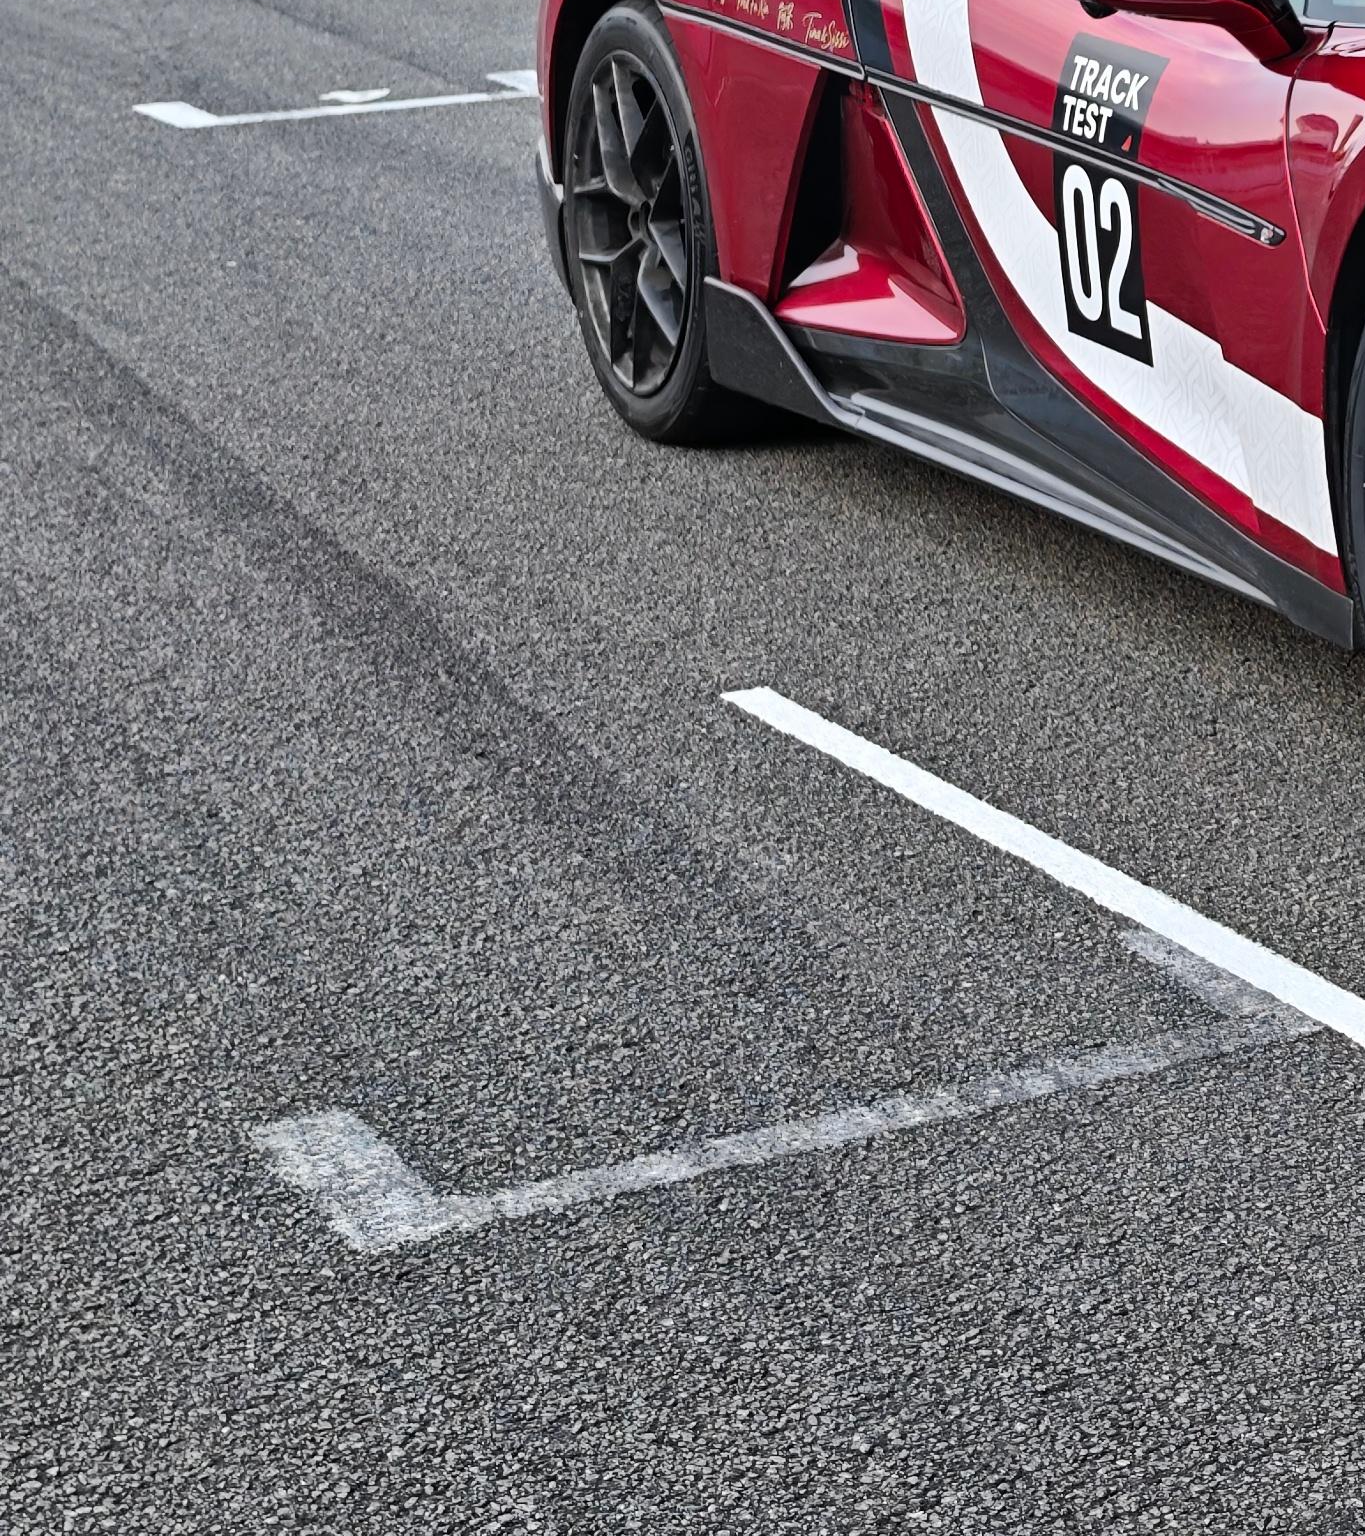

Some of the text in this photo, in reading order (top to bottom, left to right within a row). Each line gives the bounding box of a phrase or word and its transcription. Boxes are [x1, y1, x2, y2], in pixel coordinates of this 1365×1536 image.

[1069, 55, 1149, 111] TRACK
[1062, 95, 1114, 144] TEST
[1061, 164, 1143, 340] 02
